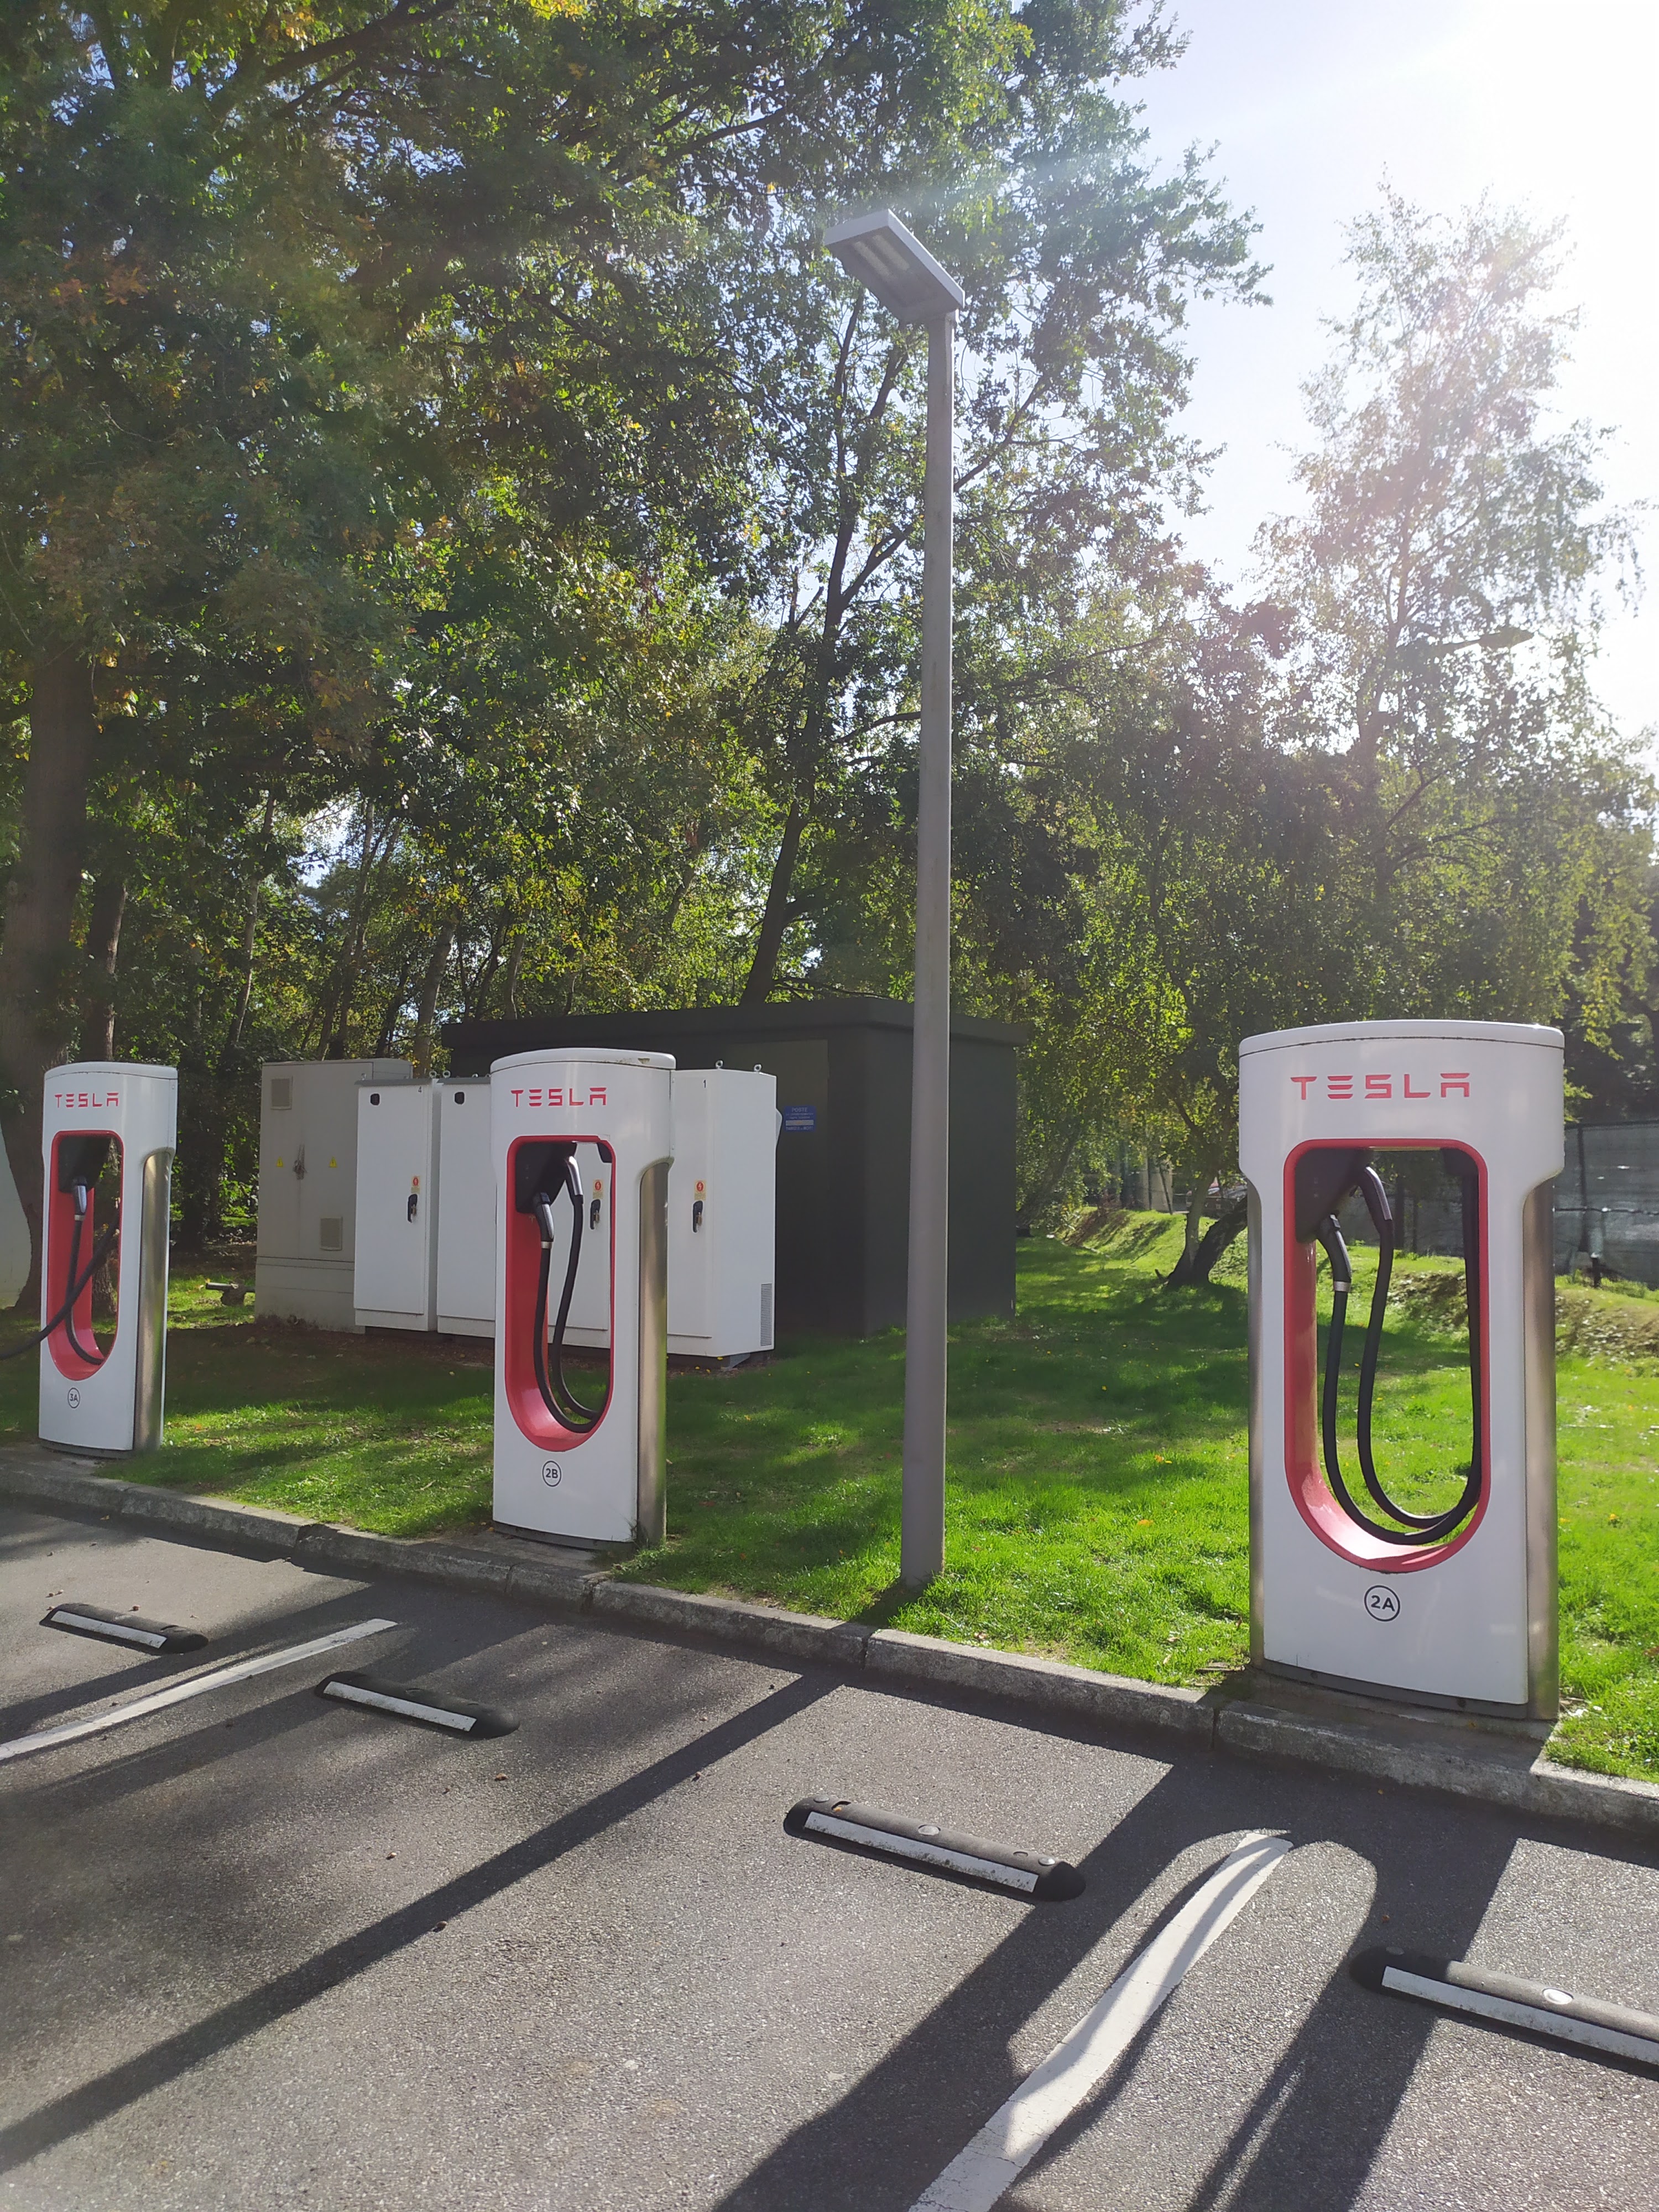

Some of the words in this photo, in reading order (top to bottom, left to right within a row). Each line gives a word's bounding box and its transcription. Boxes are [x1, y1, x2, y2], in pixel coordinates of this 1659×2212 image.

[703, 1079, 706, 1088] 1
[1290, 1073, 1469, 1100] TESLA
[54, 1092, 119, 1108] TESLA
[510, 1087, 607, 1107] TESLA
[70, 1393, 79, 1402] 3A
[546, 1468, 559, 1478] 2B
[1371, 1595, 1395, 1612] 2A
